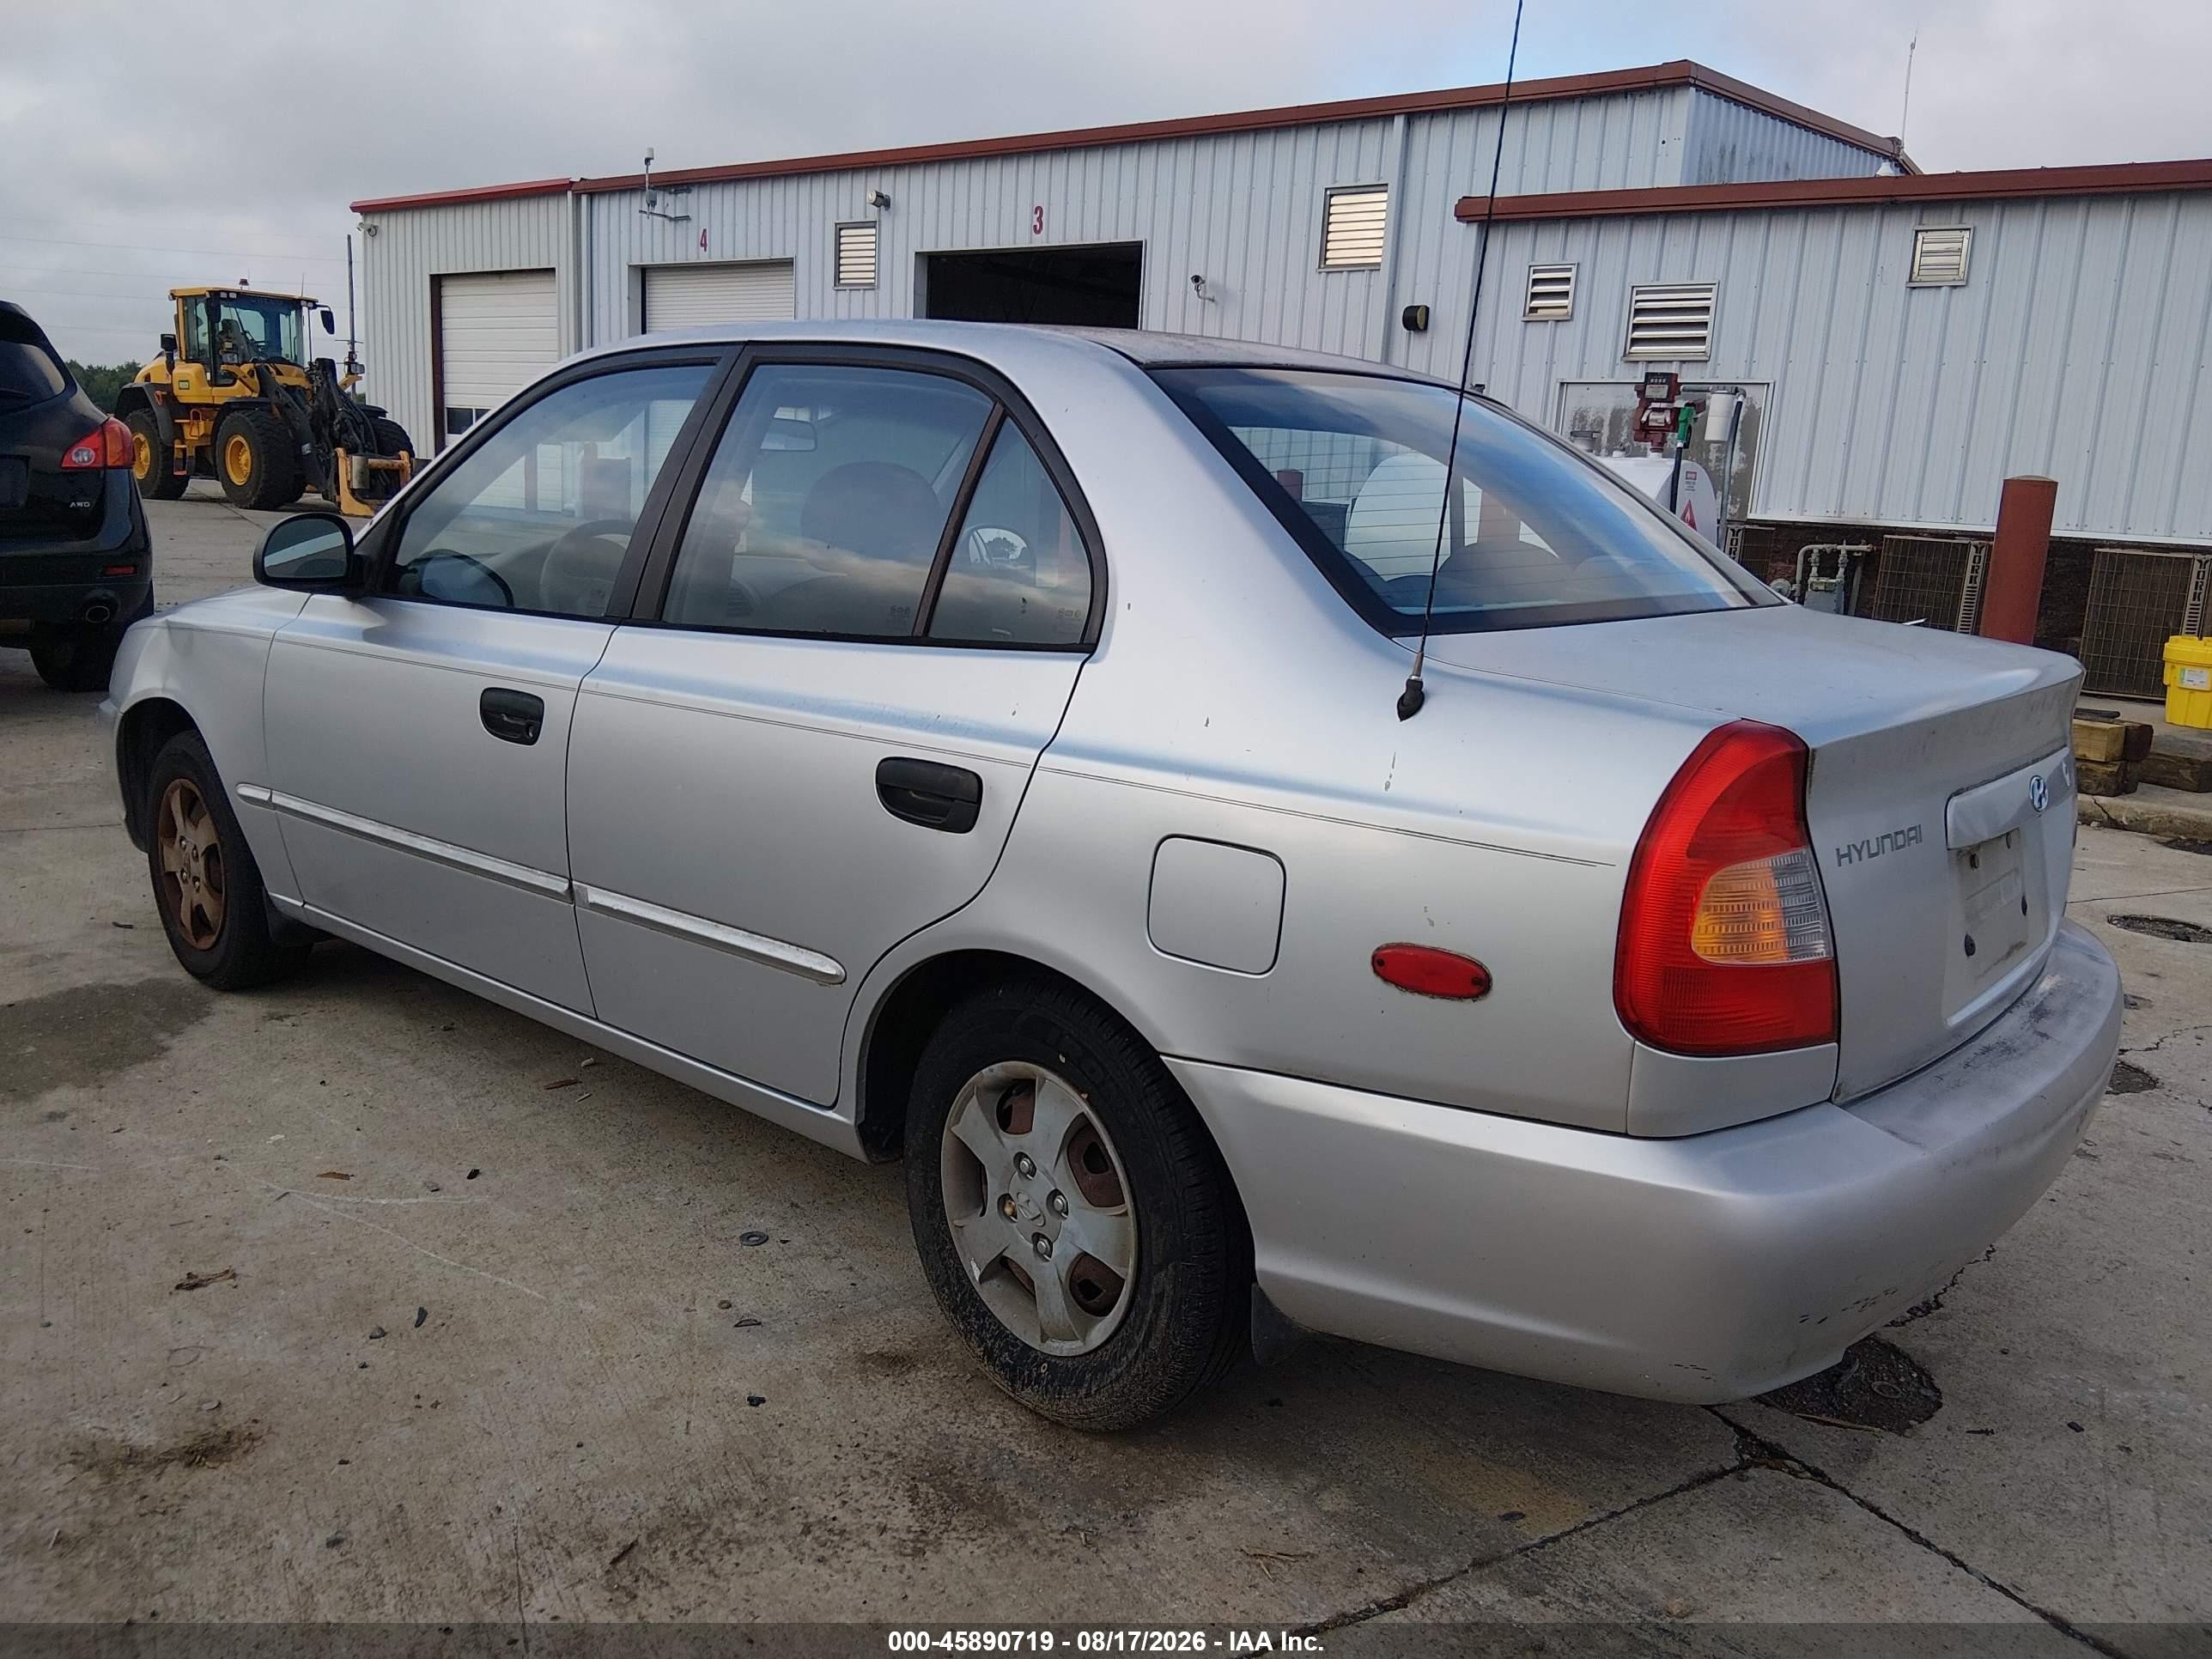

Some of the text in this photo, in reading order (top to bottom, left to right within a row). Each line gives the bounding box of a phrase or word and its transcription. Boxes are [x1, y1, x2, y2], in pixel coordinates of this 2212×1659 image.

[1033, 205, 1043, 234] 3
[700, 228, 708, 252] 4
[1728, 528, 1743, 560] YOR
[1968, 543, 1986, 585] YORK
[2191, 559, 2210, 602] YORK
[1836, 823, 1923, 867] HYUNDAI
